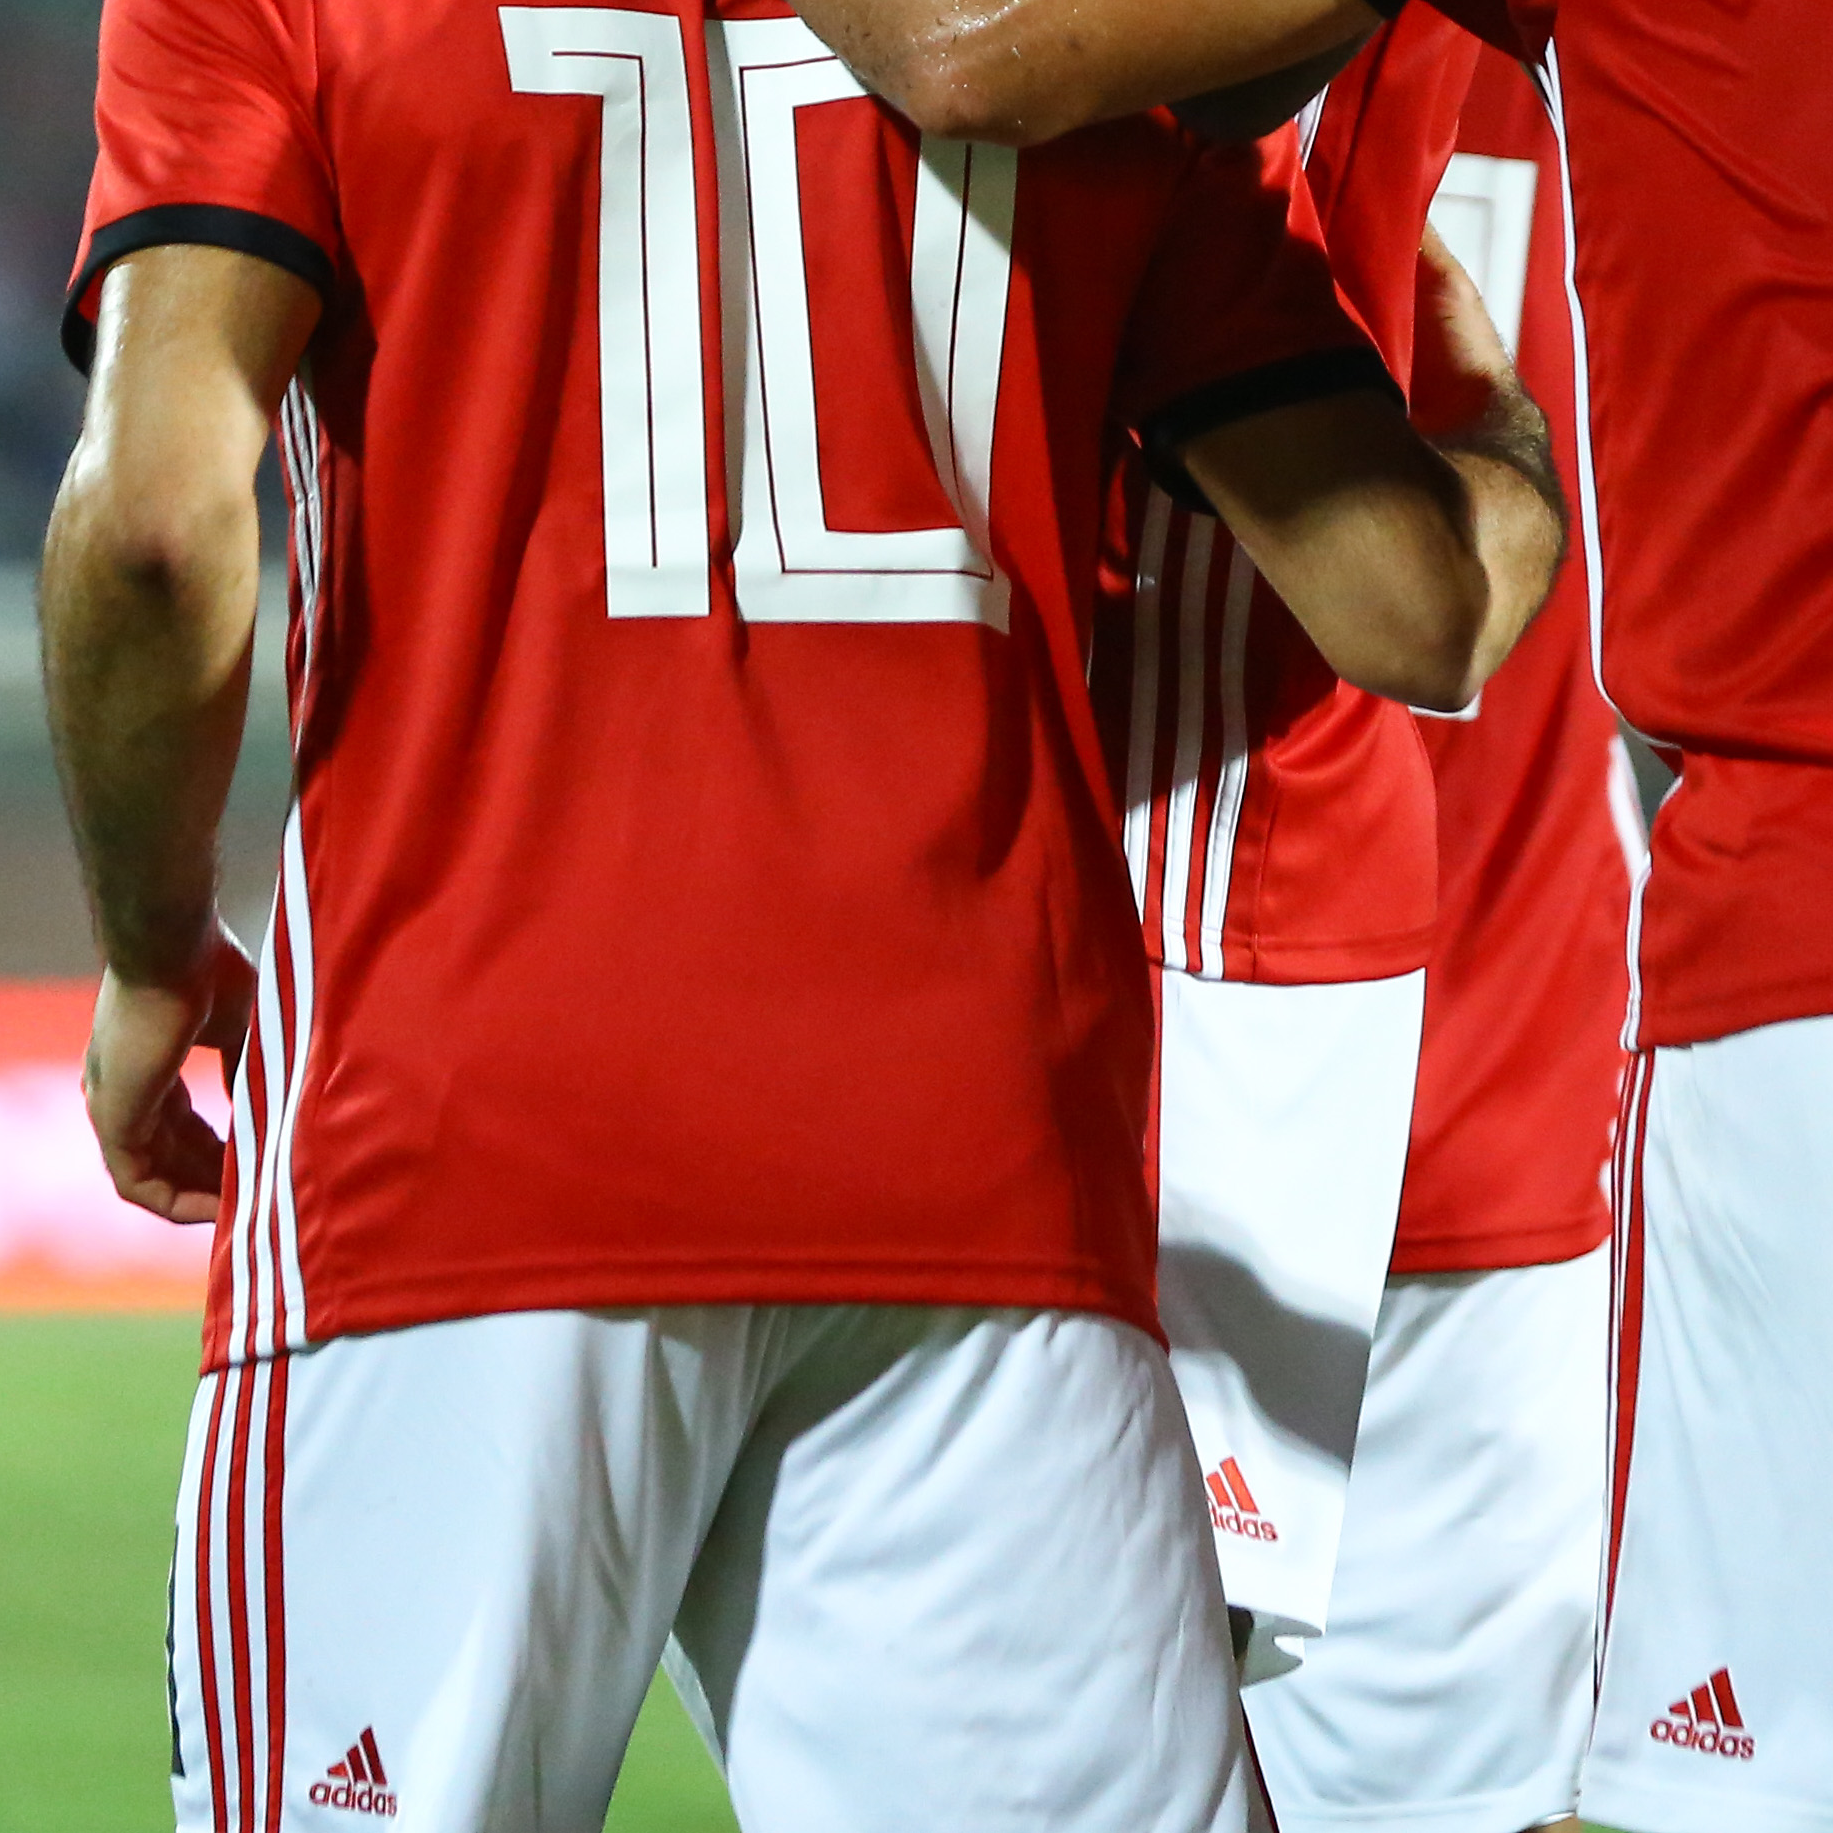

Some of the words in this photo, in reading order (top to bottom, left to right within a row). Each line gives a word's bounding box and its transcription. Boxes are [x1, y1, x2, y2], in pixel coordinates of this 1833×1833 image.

[497, 5, 1016, 635] 10
[1650, 1715, 1755, 1760] adidas
[309, 1779, 398, 1817] adidas
